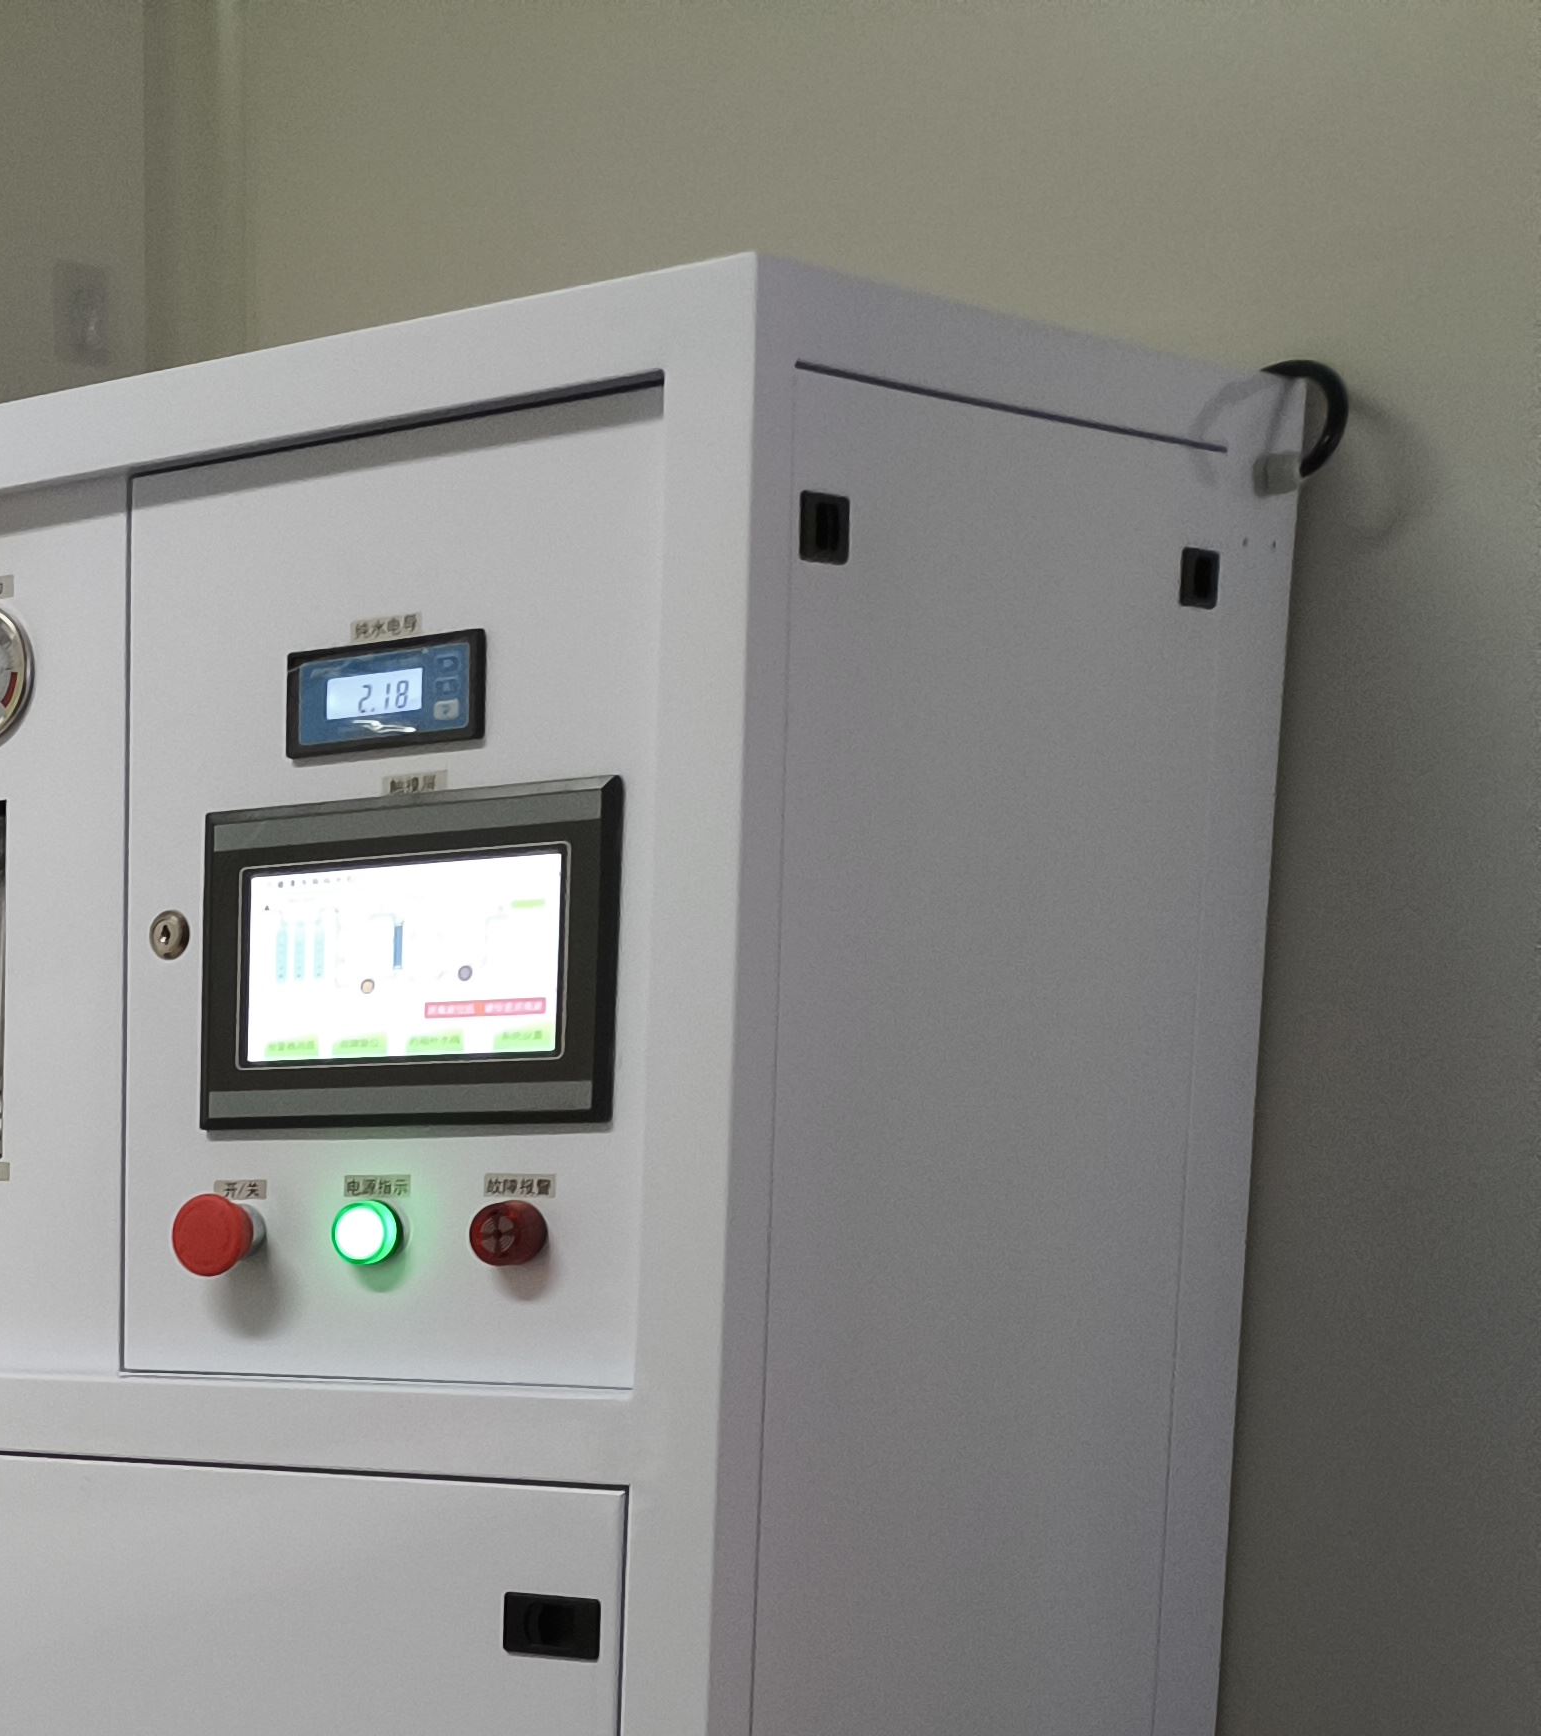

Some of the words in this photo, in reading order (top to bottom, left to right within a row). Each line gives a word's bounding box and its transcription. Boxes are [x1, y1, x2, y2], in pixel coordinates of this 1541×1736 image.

[357, 679, 411, 715] 2.18
[345, 1176, 410, 1198] 电源指示
